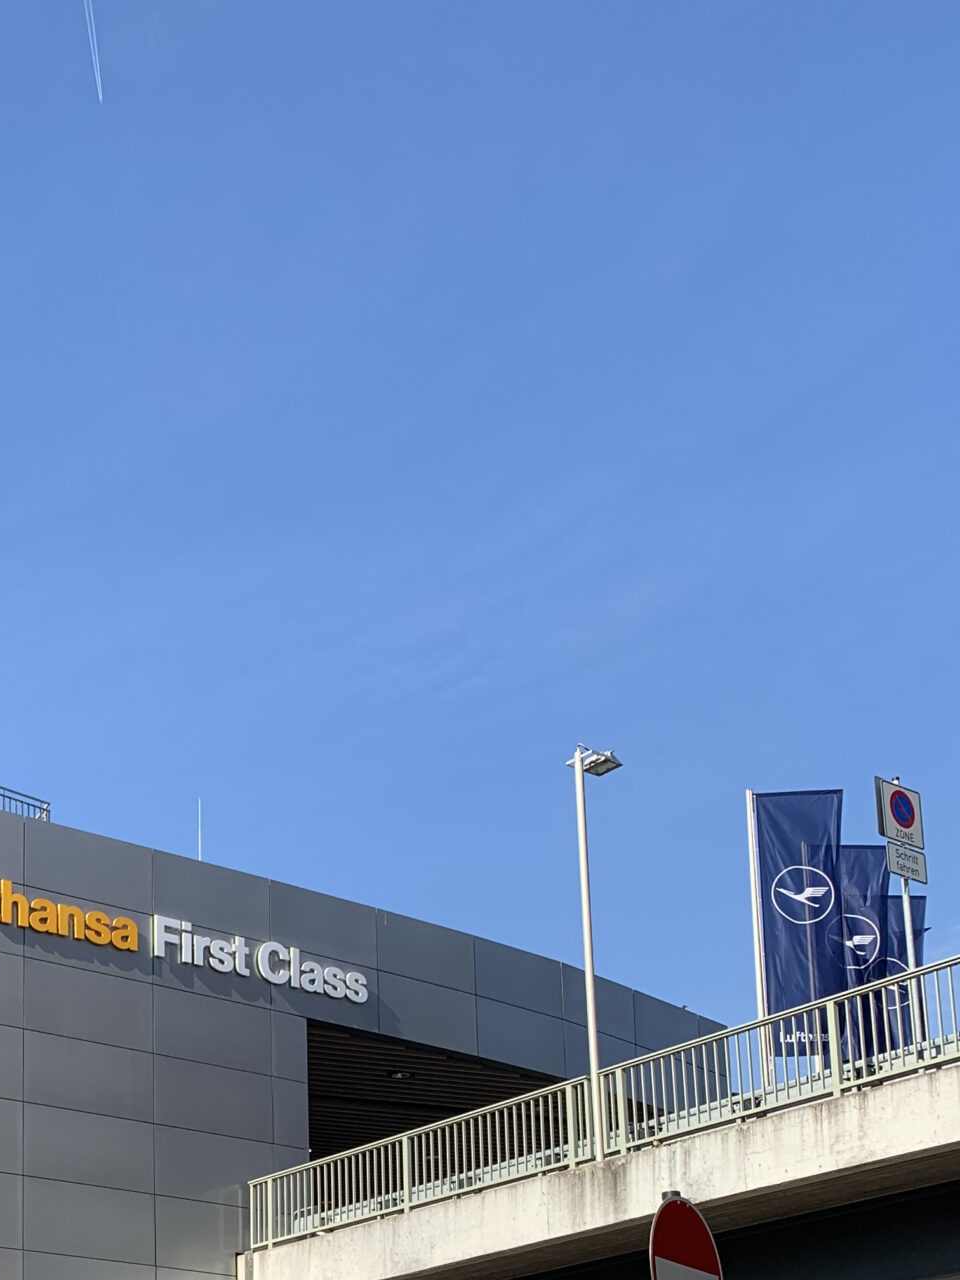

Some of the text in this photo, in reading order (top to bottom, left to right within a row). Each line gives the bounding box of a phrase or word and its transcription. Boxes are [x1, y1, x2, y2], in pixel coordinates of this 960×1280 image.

[895, 828, 915, 843] ZONE
[895, 848, 919, 865] Schritt
[896, 860, 920, 877] fahren
[152, 913, 250, 978] First
[257, 941, 370, 1004] Class
